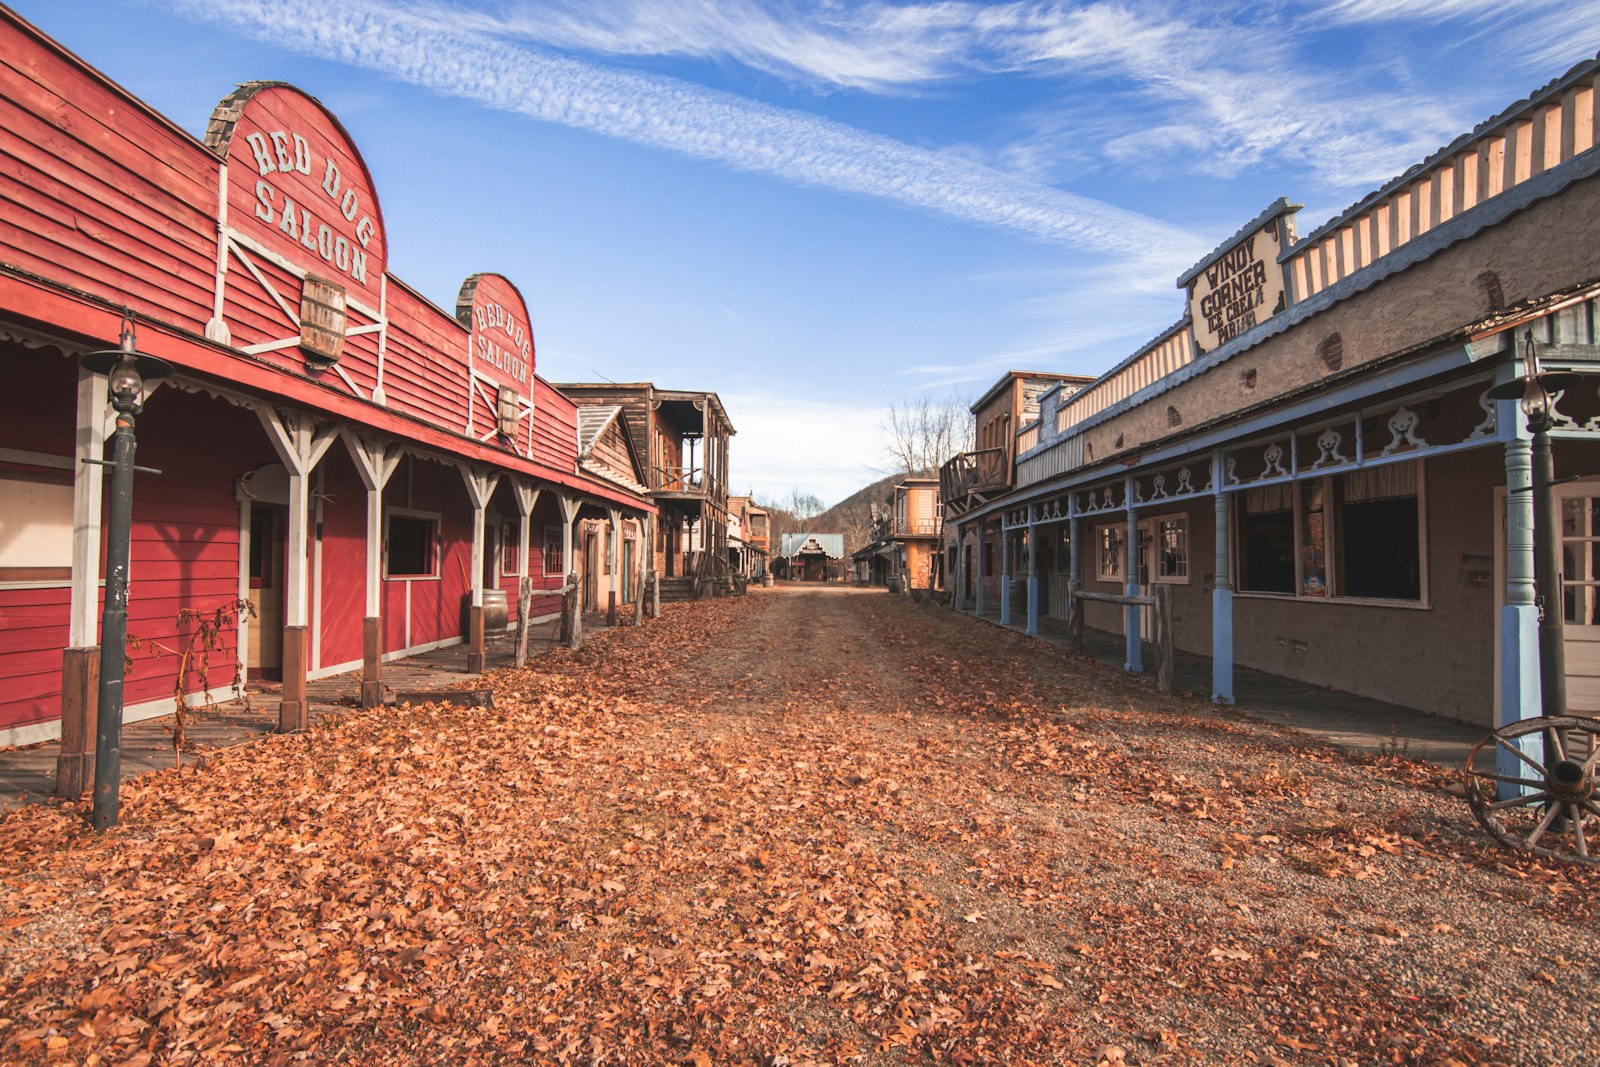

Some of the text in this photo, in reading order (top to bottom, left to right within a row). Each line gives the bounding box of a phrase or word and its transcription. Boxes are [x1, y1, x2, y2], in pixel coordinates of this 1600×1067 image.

[245, 131, 375, 250] RED DOG
[254, 179, 367, 286] SALOON
[1200, 259, 1267, 319] CORNER
[1205, 237, 1256, 290] WINDY
[475, 303, 530, 362] RED DOG
[1207, 308, 1224, 334] ICE
[477, 334, 527, 385] SALOON
